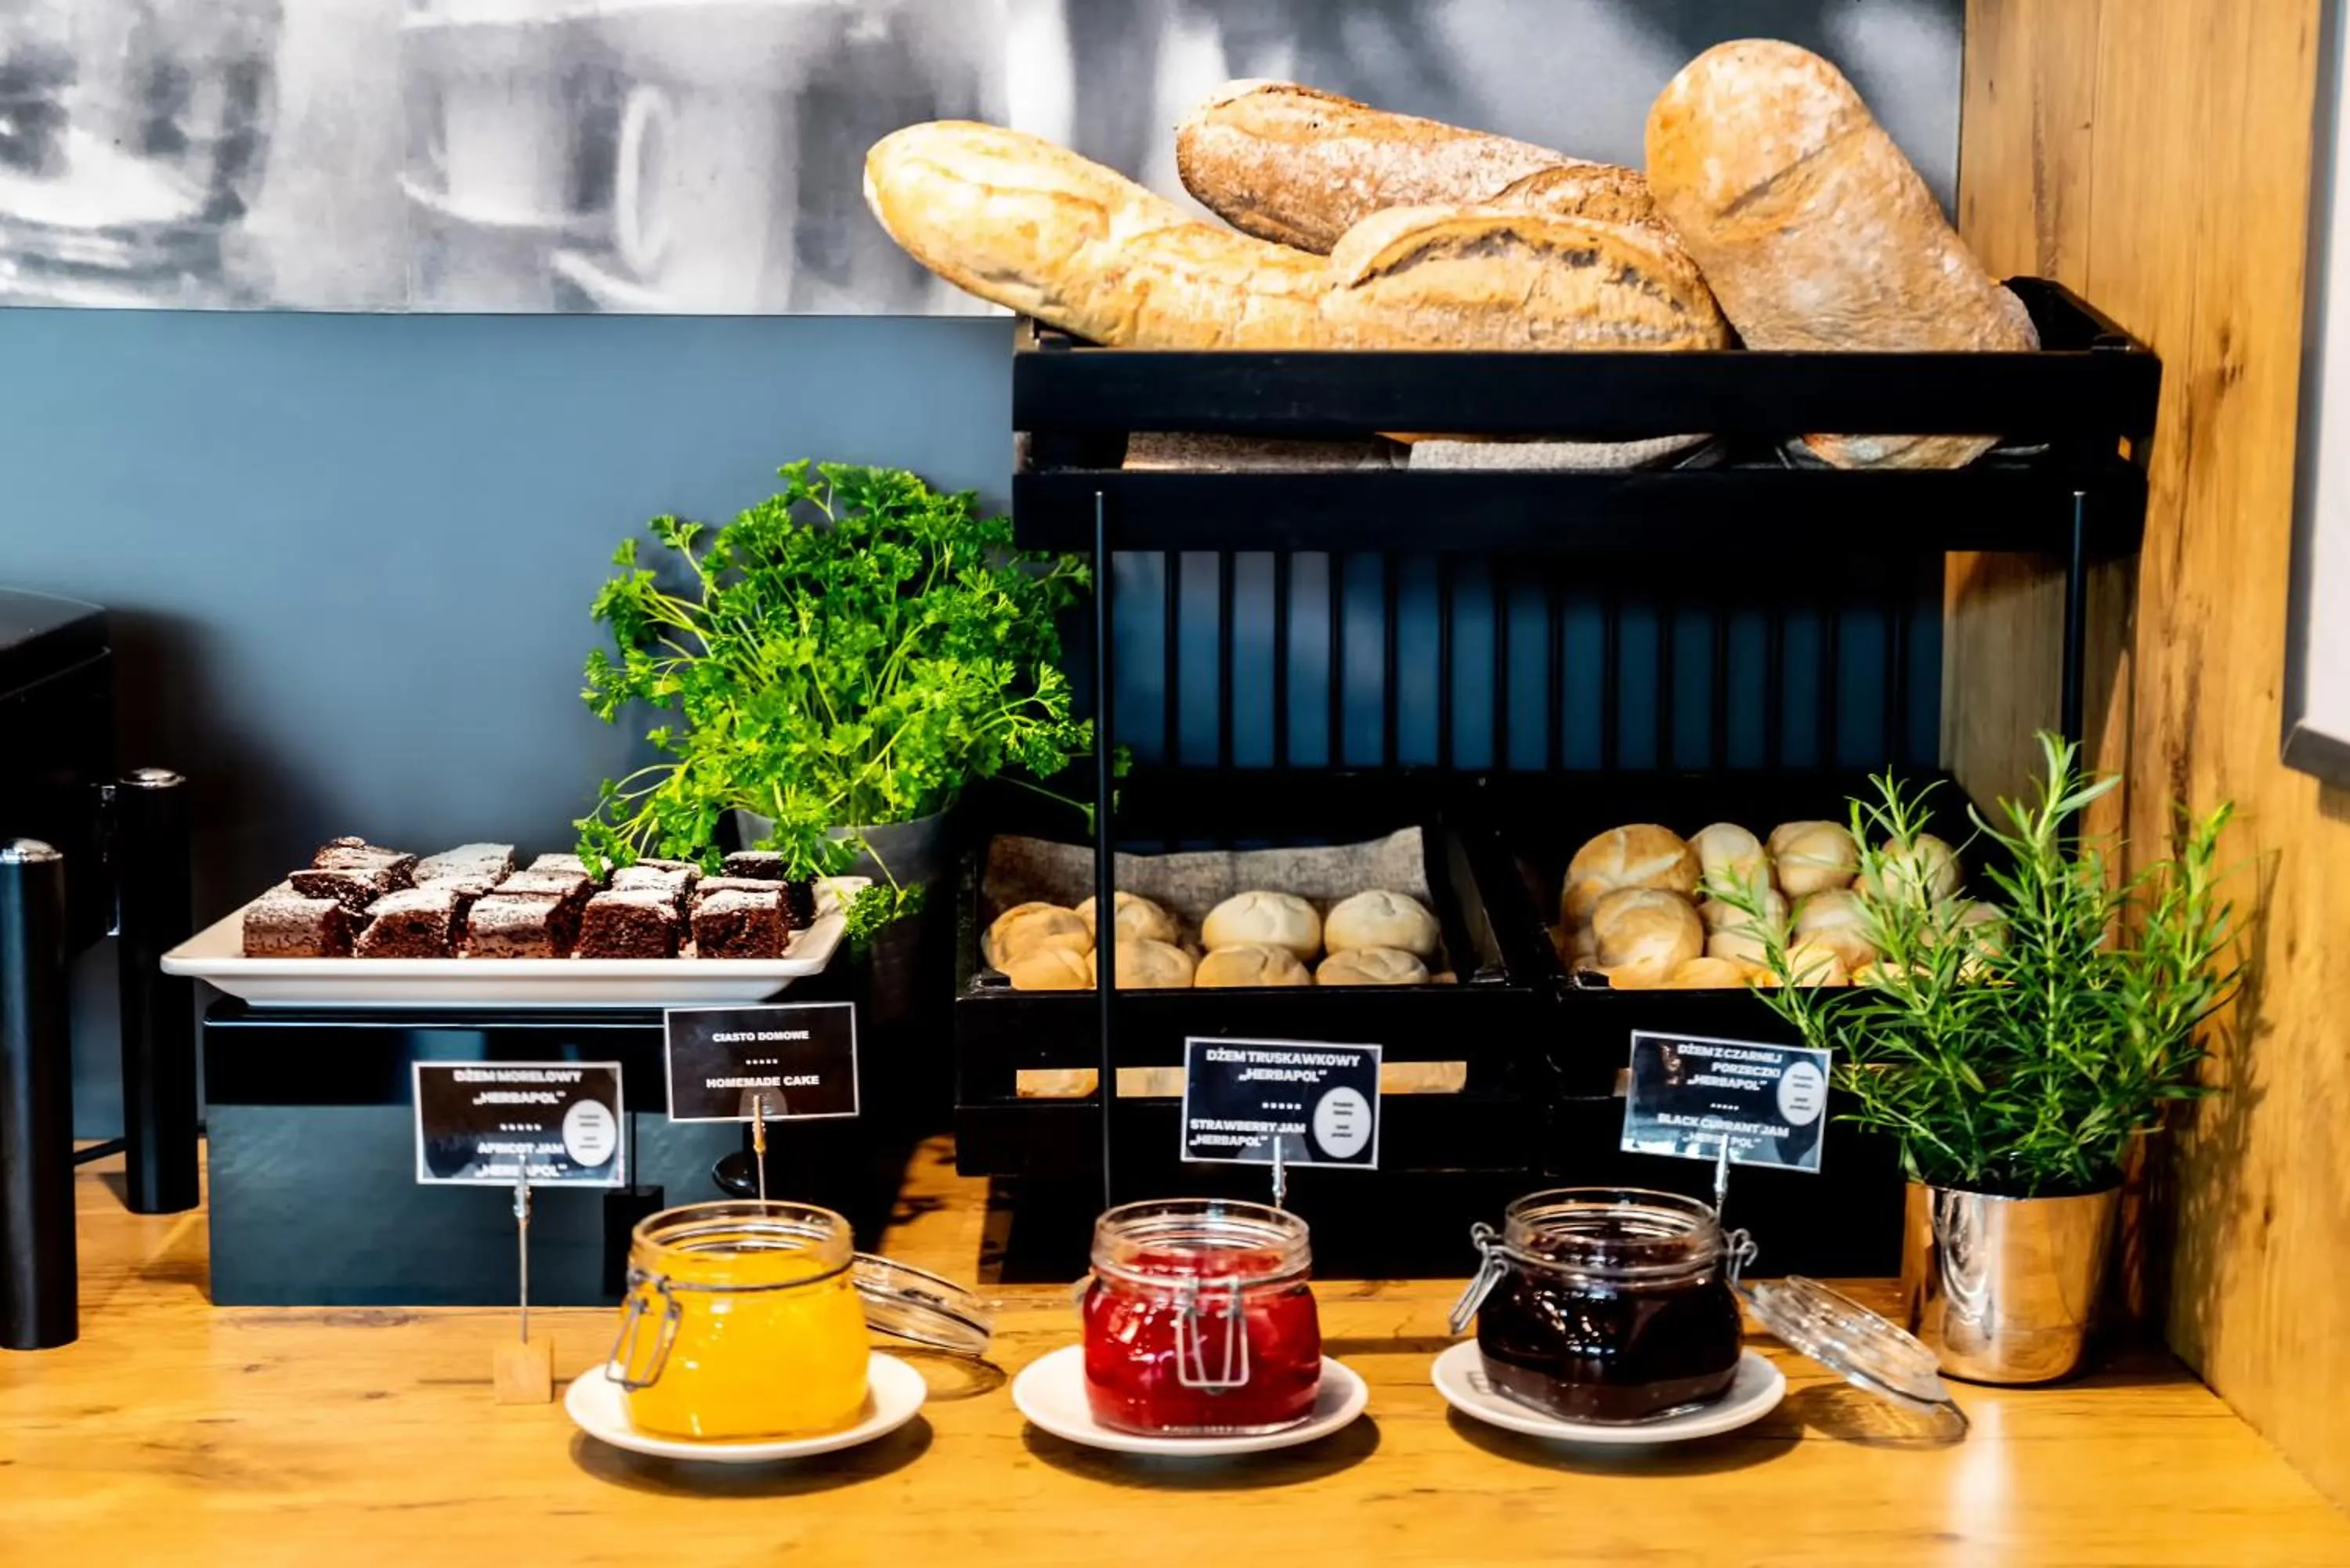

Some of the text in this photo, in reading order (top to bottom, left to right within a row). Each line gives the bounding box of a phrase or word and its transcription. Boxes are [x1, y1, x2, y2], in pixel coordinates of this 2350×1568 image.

[712, 1030, 810, 1042] CIASTO DOMOWE
[1206, 1048, 1361, 1067] DŻEM TRUSKAWKOWY
[1713, 1048, 1723, 1057] Z
[1711, 1062, 1781, 1078] PORZECZKI
[706, 1075, 820, 1089] HOMEMADE CAKE
[1190, 1119, 1306, 1133] STRAWBERRY JAM
[1658, 1113, 1699, 1127] BLACK
[1762, 1123, 1790, 1137] JAM
[477, 1143, 565, 1154] APRICOT JAM
